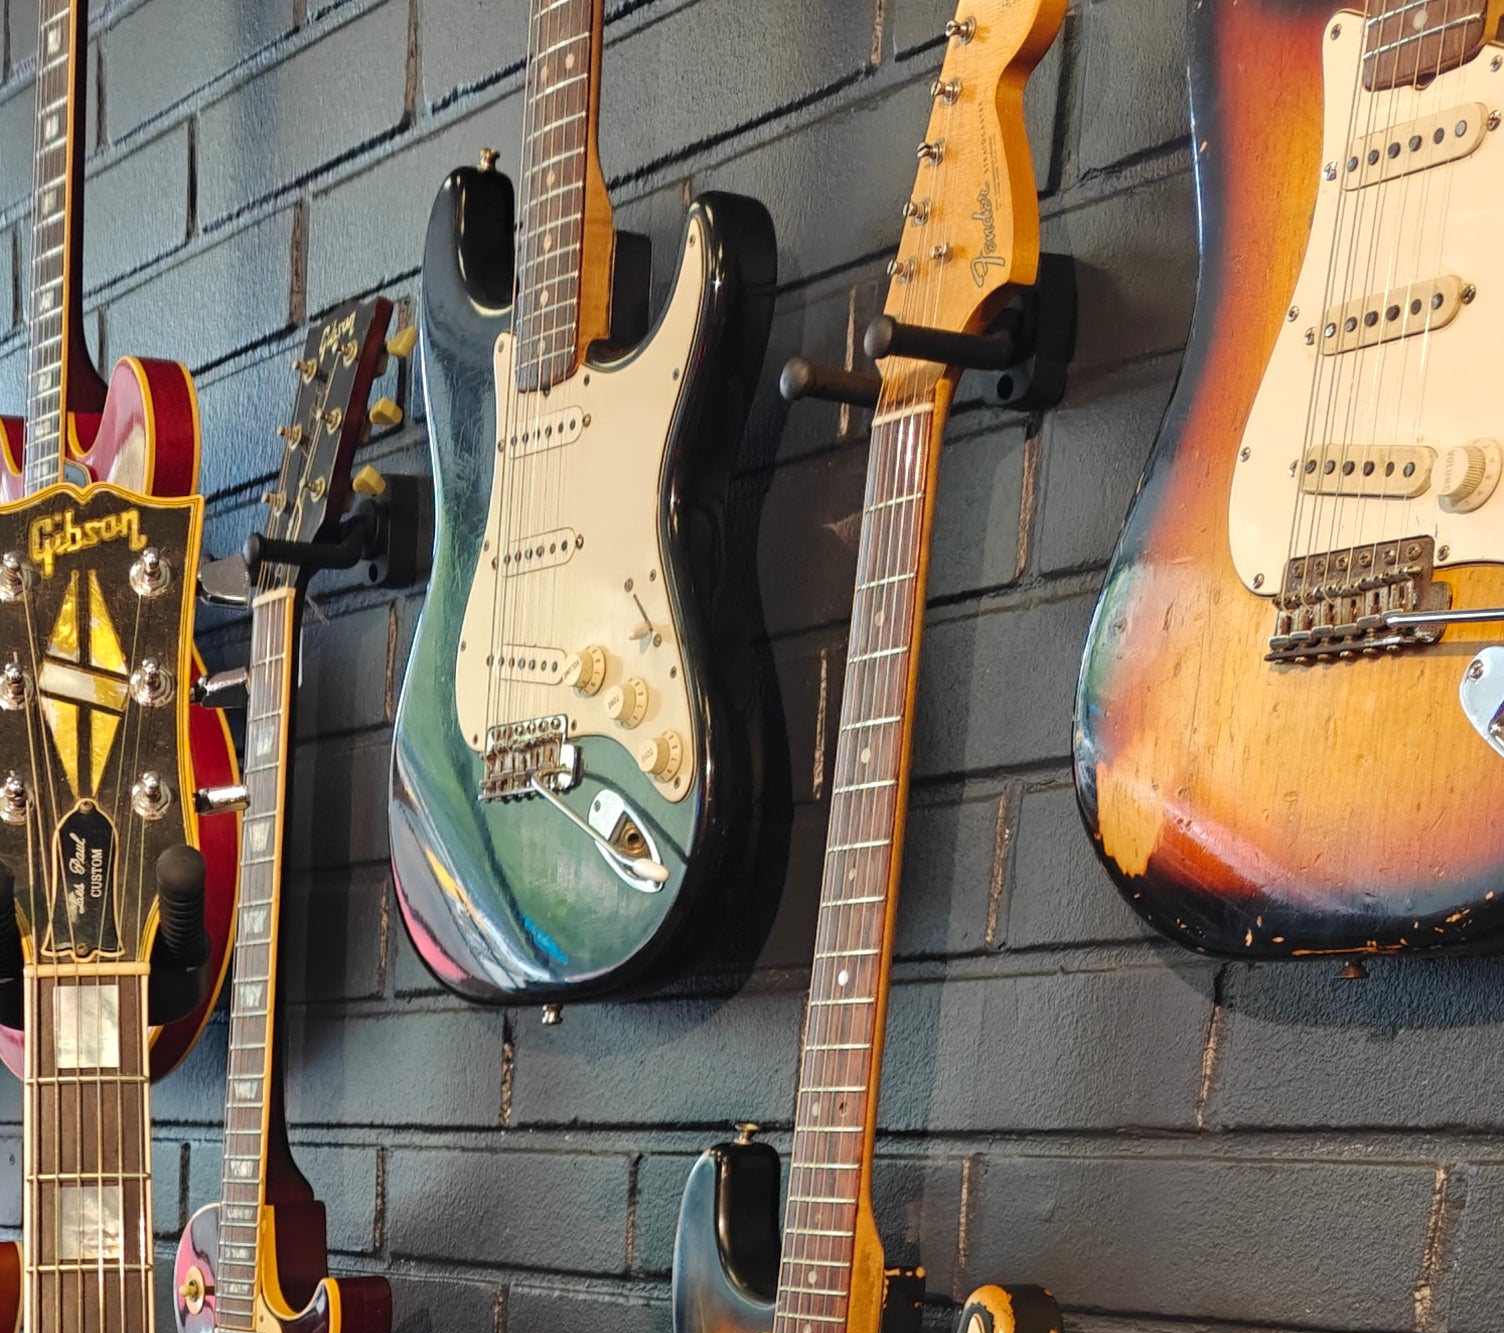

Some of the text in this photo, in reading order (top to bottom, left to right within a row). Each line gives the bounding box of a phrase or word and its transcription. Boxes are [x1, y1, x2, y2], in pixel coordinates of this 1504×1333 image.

[970, 184, 1006, 288] Fender
[318, 310, 356, 364] Gibson
[29, 507, 147, 579] Gibson
[68, 832, 86, 914] Les Paul
[90, 848, 104, 898] CUSTOM
